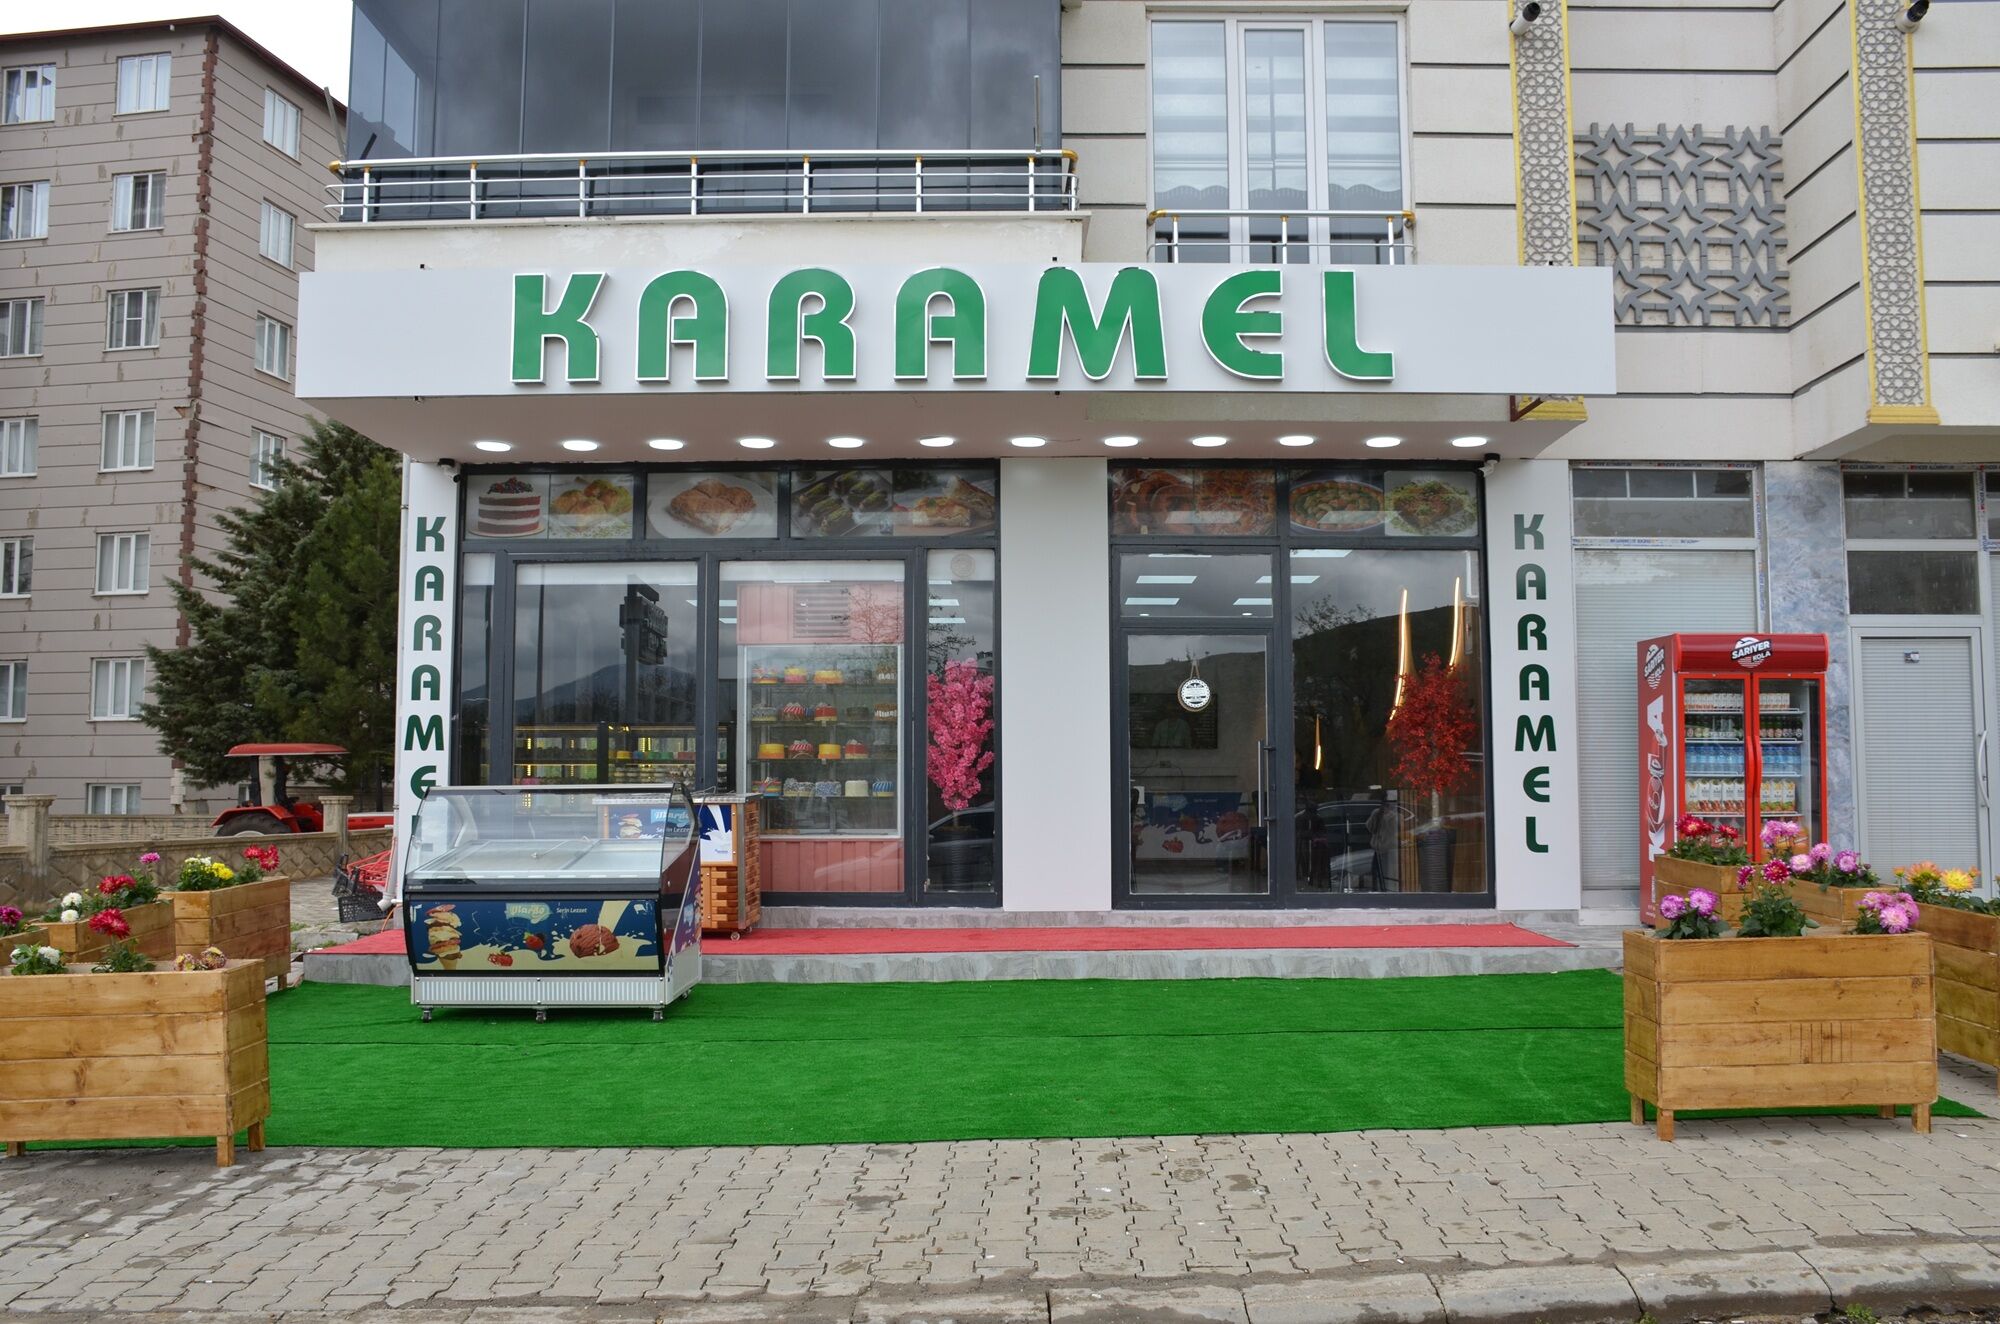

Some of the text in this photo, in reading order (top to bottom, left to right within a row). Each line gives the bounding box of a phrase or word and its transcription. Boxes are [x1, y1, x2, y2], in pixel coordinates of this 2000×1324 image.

[512, 266, 1395, 383] KARAMEL
[1513, 513, 1557, 853] KARAMEL
[1732, 641, 1770, 659] SARIYER
[1752, 651, 1772, 662] KOLA
